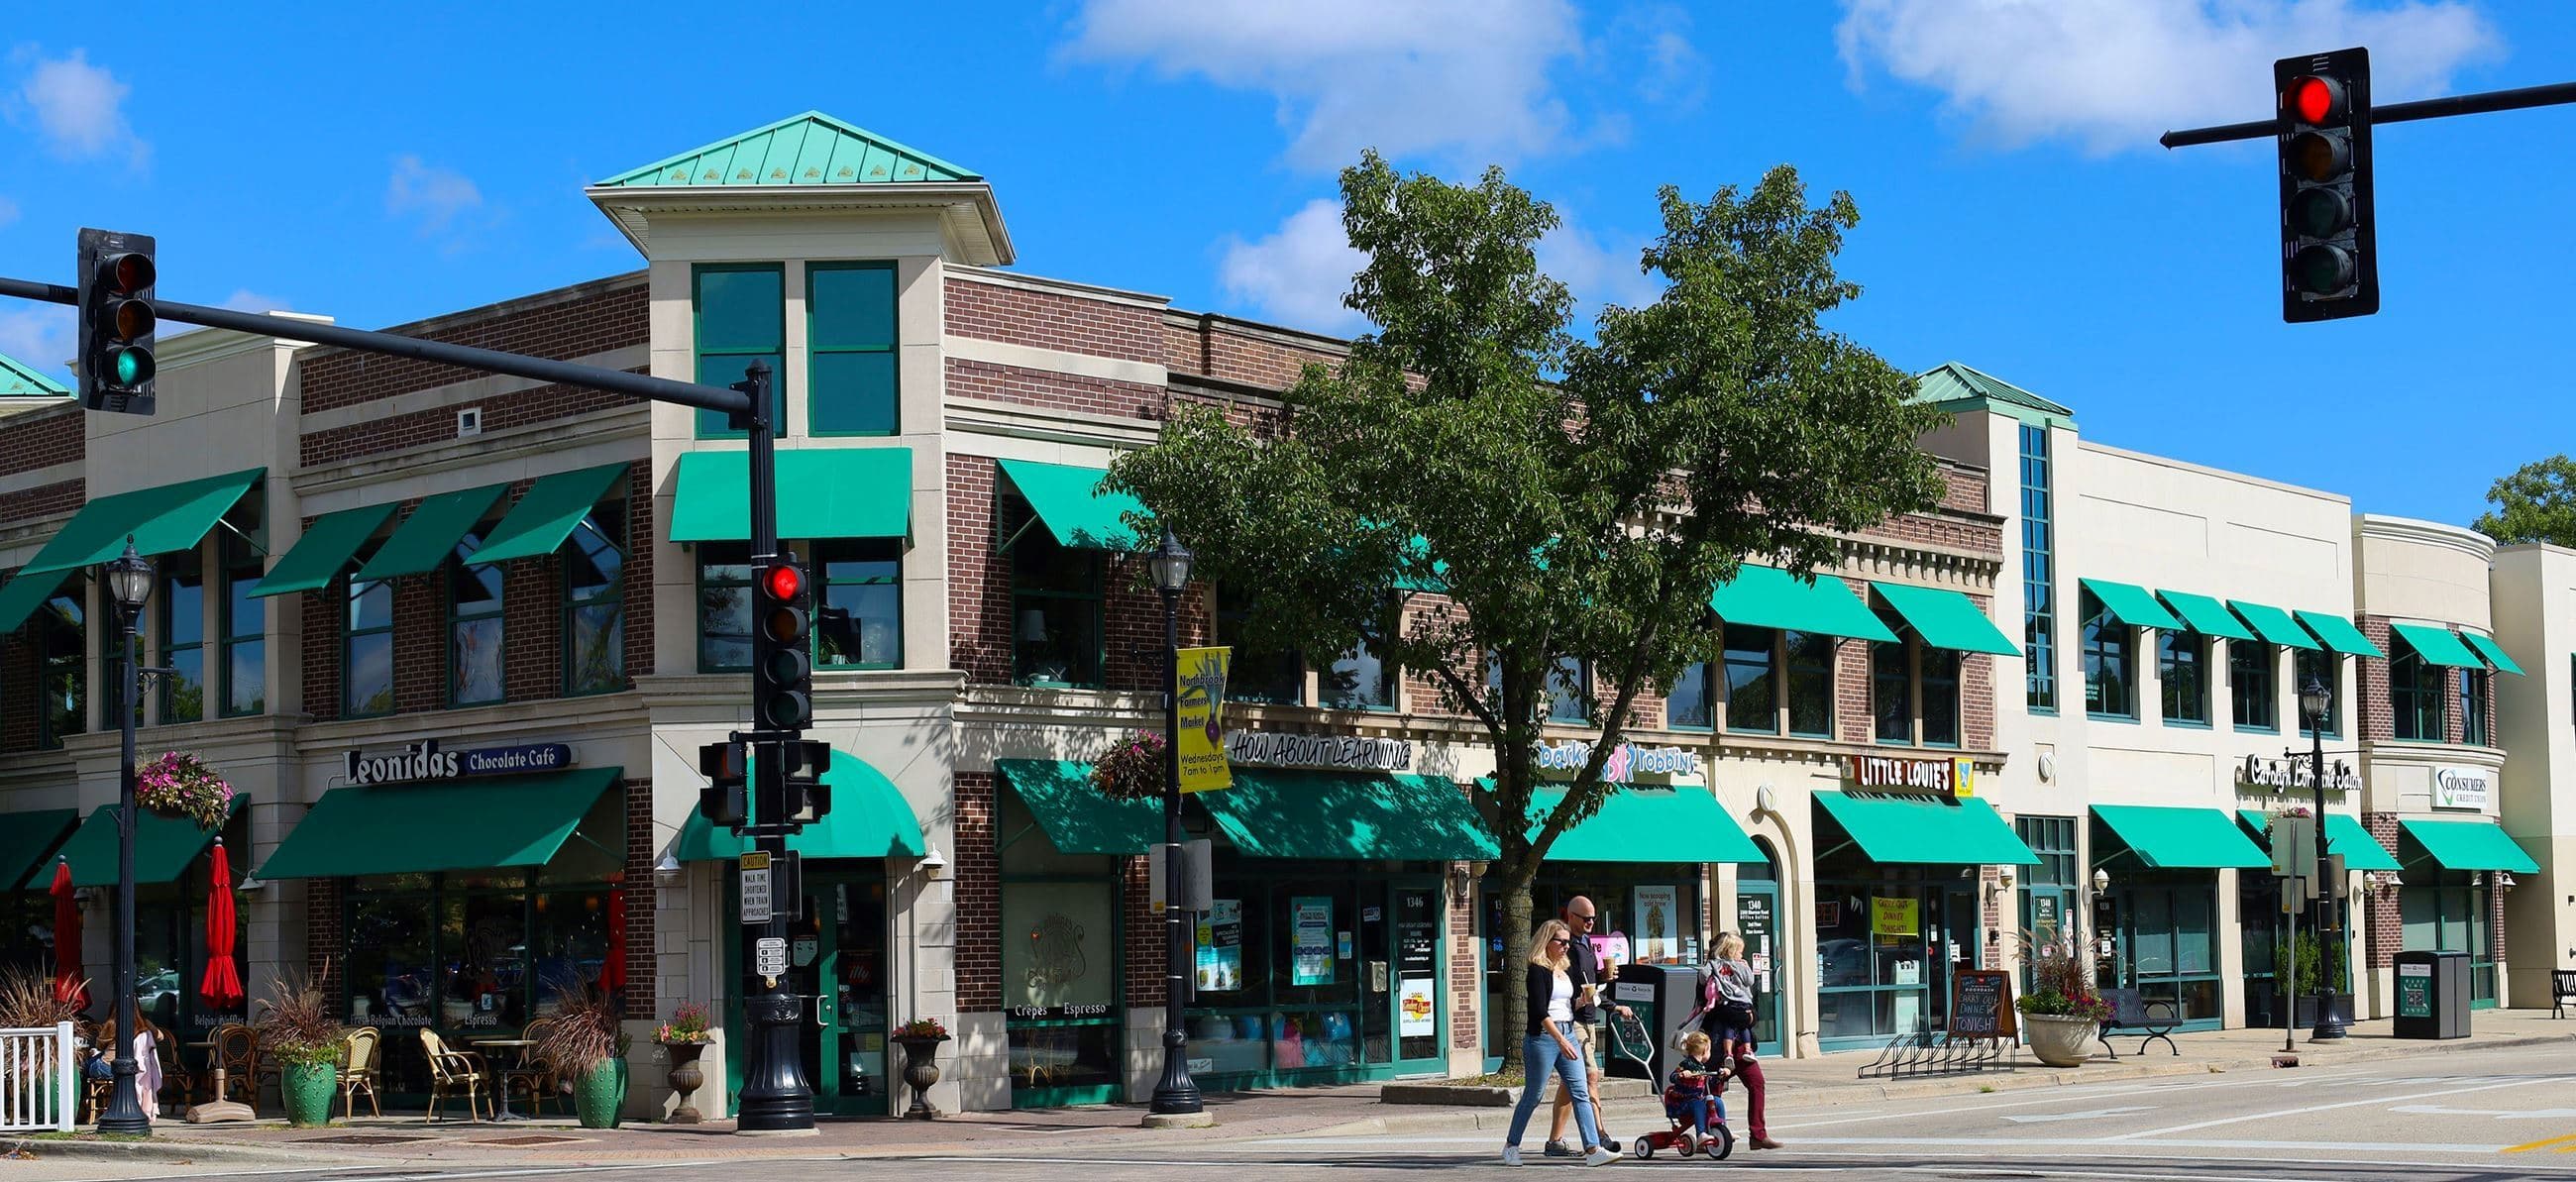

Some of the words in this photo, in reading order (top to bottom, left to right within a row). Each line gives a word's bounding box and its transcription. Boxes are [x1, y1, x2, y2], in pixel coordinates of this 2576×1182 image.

[1180, 674, 1224, 687] Northbrook
[1181, 696, 1207, 707] Farmers
[1181, 715, 1205, 729] Market
[1232, 733, 1269, 762] HOW
[1273, 735, 1330, 766] ABOUT
[1332, 737, 1411, 769] LEARNING
[1540, 740, 1590, 769] baski
[343, 739, 459, 785] Leonidas
[470, 751, 526, 771] Chocolate
[528, 747, 555, 767] Café
[1180, 752, 1225, 765] Wednesdays
[1638, 746, 1695, 775] robbins
[1183, 767, 1199, 776] 7am
[1209, 764, 1225, 775] 1pm
[1861, 756, 1902, 786] LITTLE
[1904, 759, 1951, 791] LOUIE'S
[2251, 753, 2292, 793] Carolyn
[2294, 756, 2335, 789] Lorrine
[2336, 759, 2363, 791] Salon
[2446, 777, 2487, 792] CONSUMERS
[743, 854, 768, 867] CAUTION
[745, 874, 756, 883] WALK
[757, 873, 767, 883] TIME
[744, 885, 767, 895] SHORTENED
[744, 897, 755, 906] WHEN
[756, 896, 768, 906] TRAIN
[1407, 897, 1424, 908] 1346
[1748, 900, 1762, 910] 1340
[743, 907, 769, 916] APPROACHES
[1958, 993, 1980, 1004] CARRY
[1015, 1004, 1047, 1020] Crêpes
[1064, 1002, 1107, 1019] Espresso
[371, 1014, 396, 1028] Belgian
[397, 1014, 433, 1026] Chocolate
[465, 1014, 497, 1028] Espresso
[1955, 1017, 1997, 1031] TONIGHT
